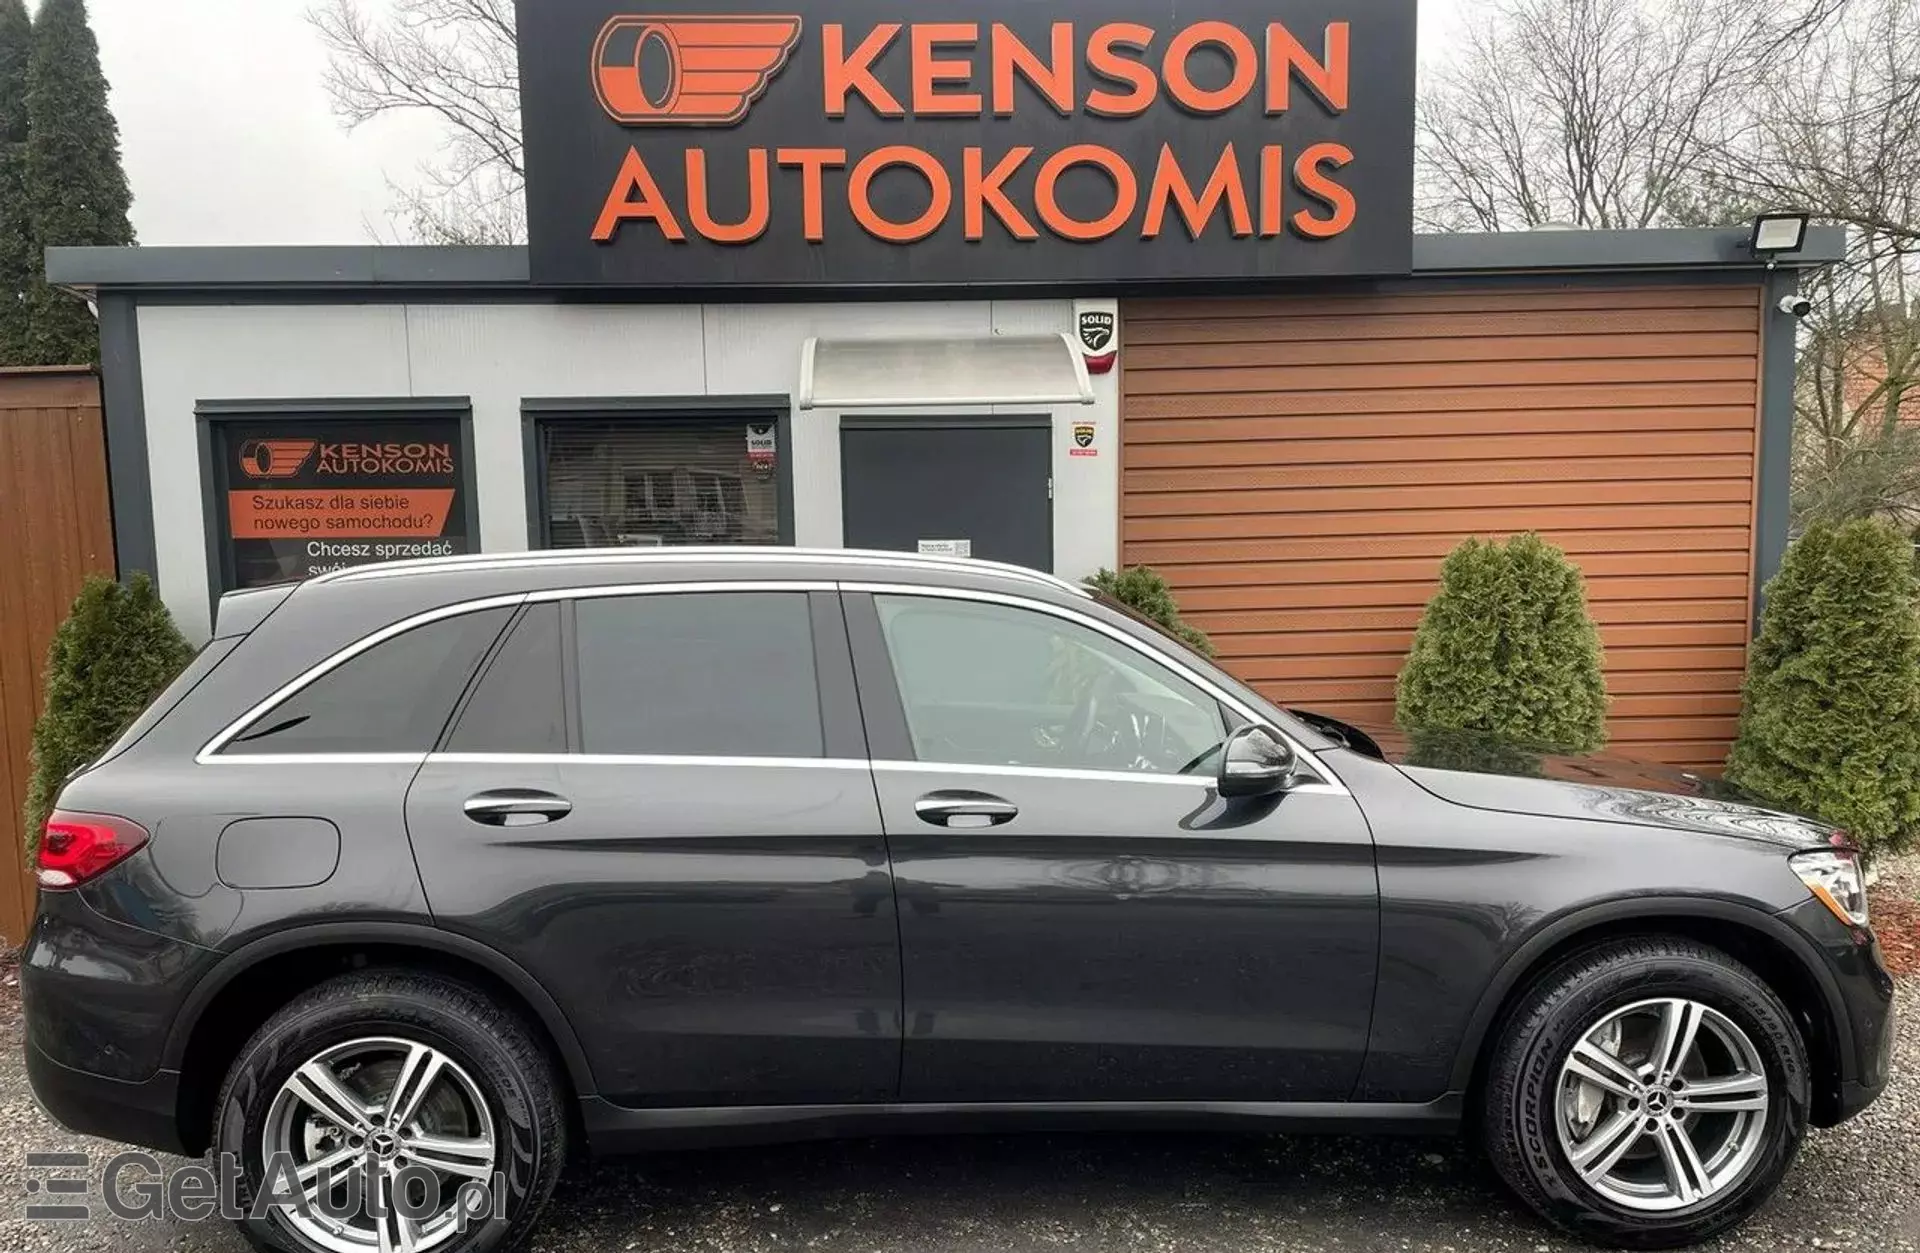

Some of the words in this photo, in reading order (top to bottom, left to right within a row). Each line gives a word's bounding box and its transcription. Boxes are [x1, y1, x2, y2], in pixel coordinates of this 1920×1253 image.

[822, 20, 1350, 118] KENSON
[591, 140, 1356, 244] AUTOKOMIS
[1081, 315, 1112, 325] SOLID
[320, 443, 449, 458] KENSON
[316, 458, 454, 474] AUTOKOMIS
[252, 495, 324, 510] Szukasz
[329, 494, 354, 509] dla
[360, 493, 410, 509] siebie
[254, 515, 321, 532] nowego
[326, 513, 433, 529] samochodu?
[307, 541, 371, 557] Chcesz
[375, 540, 452, 559] sprzedać
[1525, 1037, 1553, 1170] SCORPION
